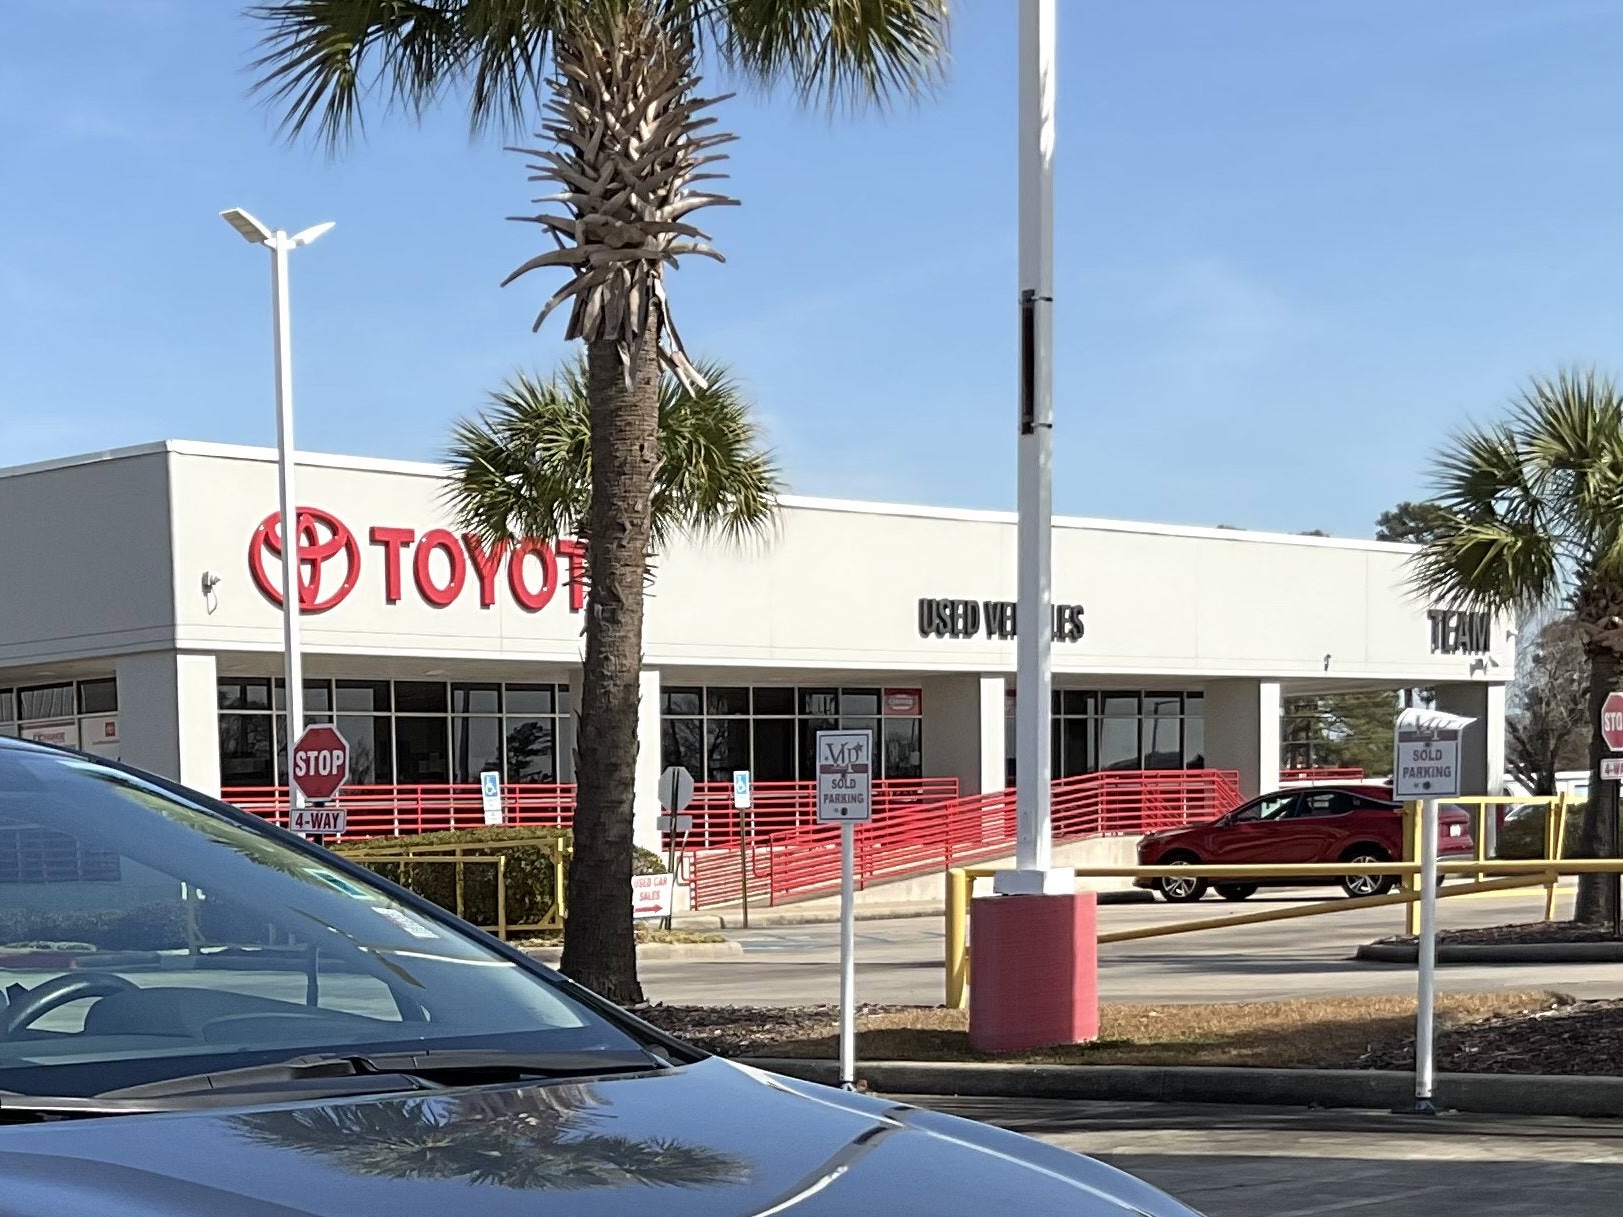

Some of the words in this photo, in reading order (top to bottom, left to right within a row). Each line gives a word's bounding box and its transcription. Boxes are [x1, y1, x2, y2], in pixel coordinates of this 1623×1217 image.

[369, 526, 589, 613] TOYOT
[918, 598, 980, 639] USED
[983, 601, 1085, 643] VELES
[1427, 609, 1491, 655] TEAM
[1604, 711, 1623, 732] STO
[295, 749, 344, 777] STOP
[1412, 749, 1443, 762] SOLD
[1402, 766, 1452, 779] PARKING
[831, 778, 857, 790] SOLD
[823, 793, 864, 805] PARKING
[295, 812, 340, 829] 4-WAY
